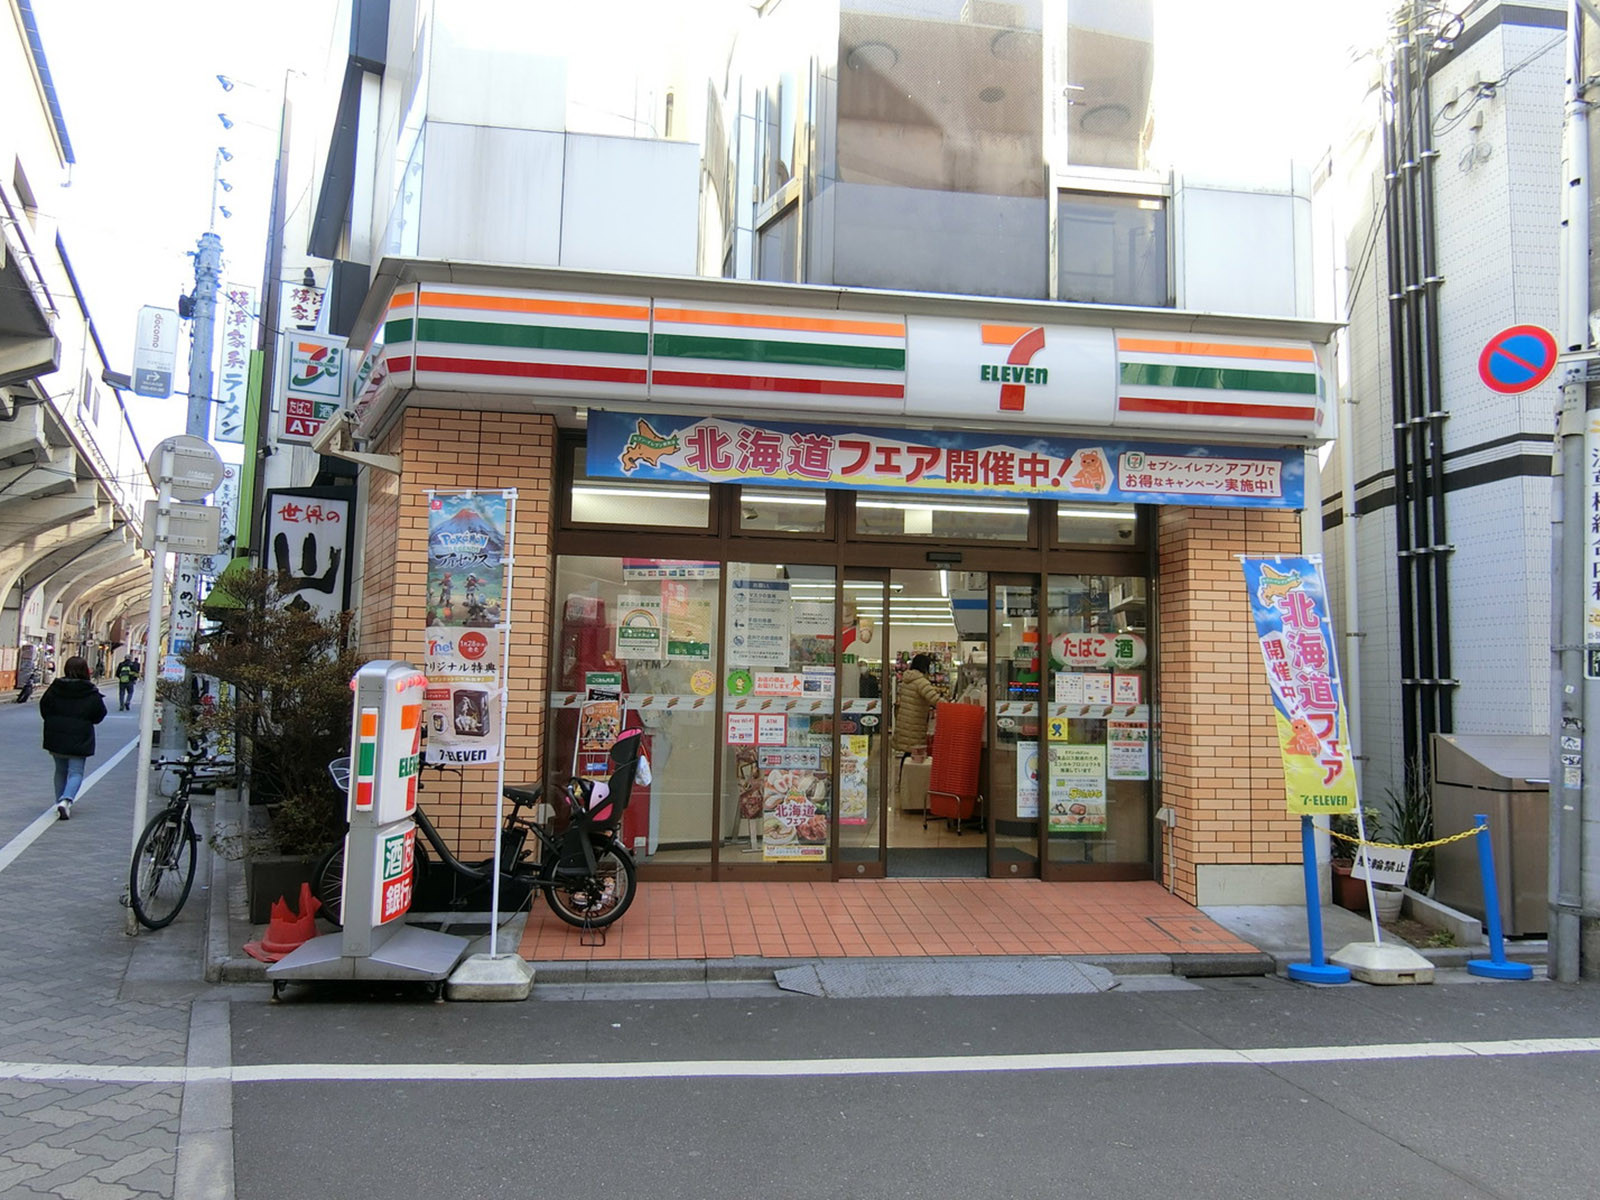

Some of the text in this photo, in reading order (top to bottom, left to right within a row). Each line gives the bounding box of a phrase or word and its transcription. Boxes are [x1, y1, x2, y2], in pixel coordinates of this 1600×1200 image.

[152, 313, 163, 349] docomo
[222, 290, 249, 436] 横浜家系ラーメン
[287, 400, 312, 416] たばこ
[684, 425, 1074, 489] 北海道フェア開催中!
[1147, 461, 1276, 477] セブン-イレブンアプリで
[1125, 474, 1275, 494] お得なキャンペーン実施中!
[277, 502, 341, 523] 世界の
[428, 640, 454, 656] 7net
[1063, 637, 1133, 658] たばこ 酒
[1280, 591, 1345, 788] 北海道フェア
[775, 805, 815, 818] 北海道
[786, 817, 807, 826] フェア
[385, 838, 404, 878] 酒
